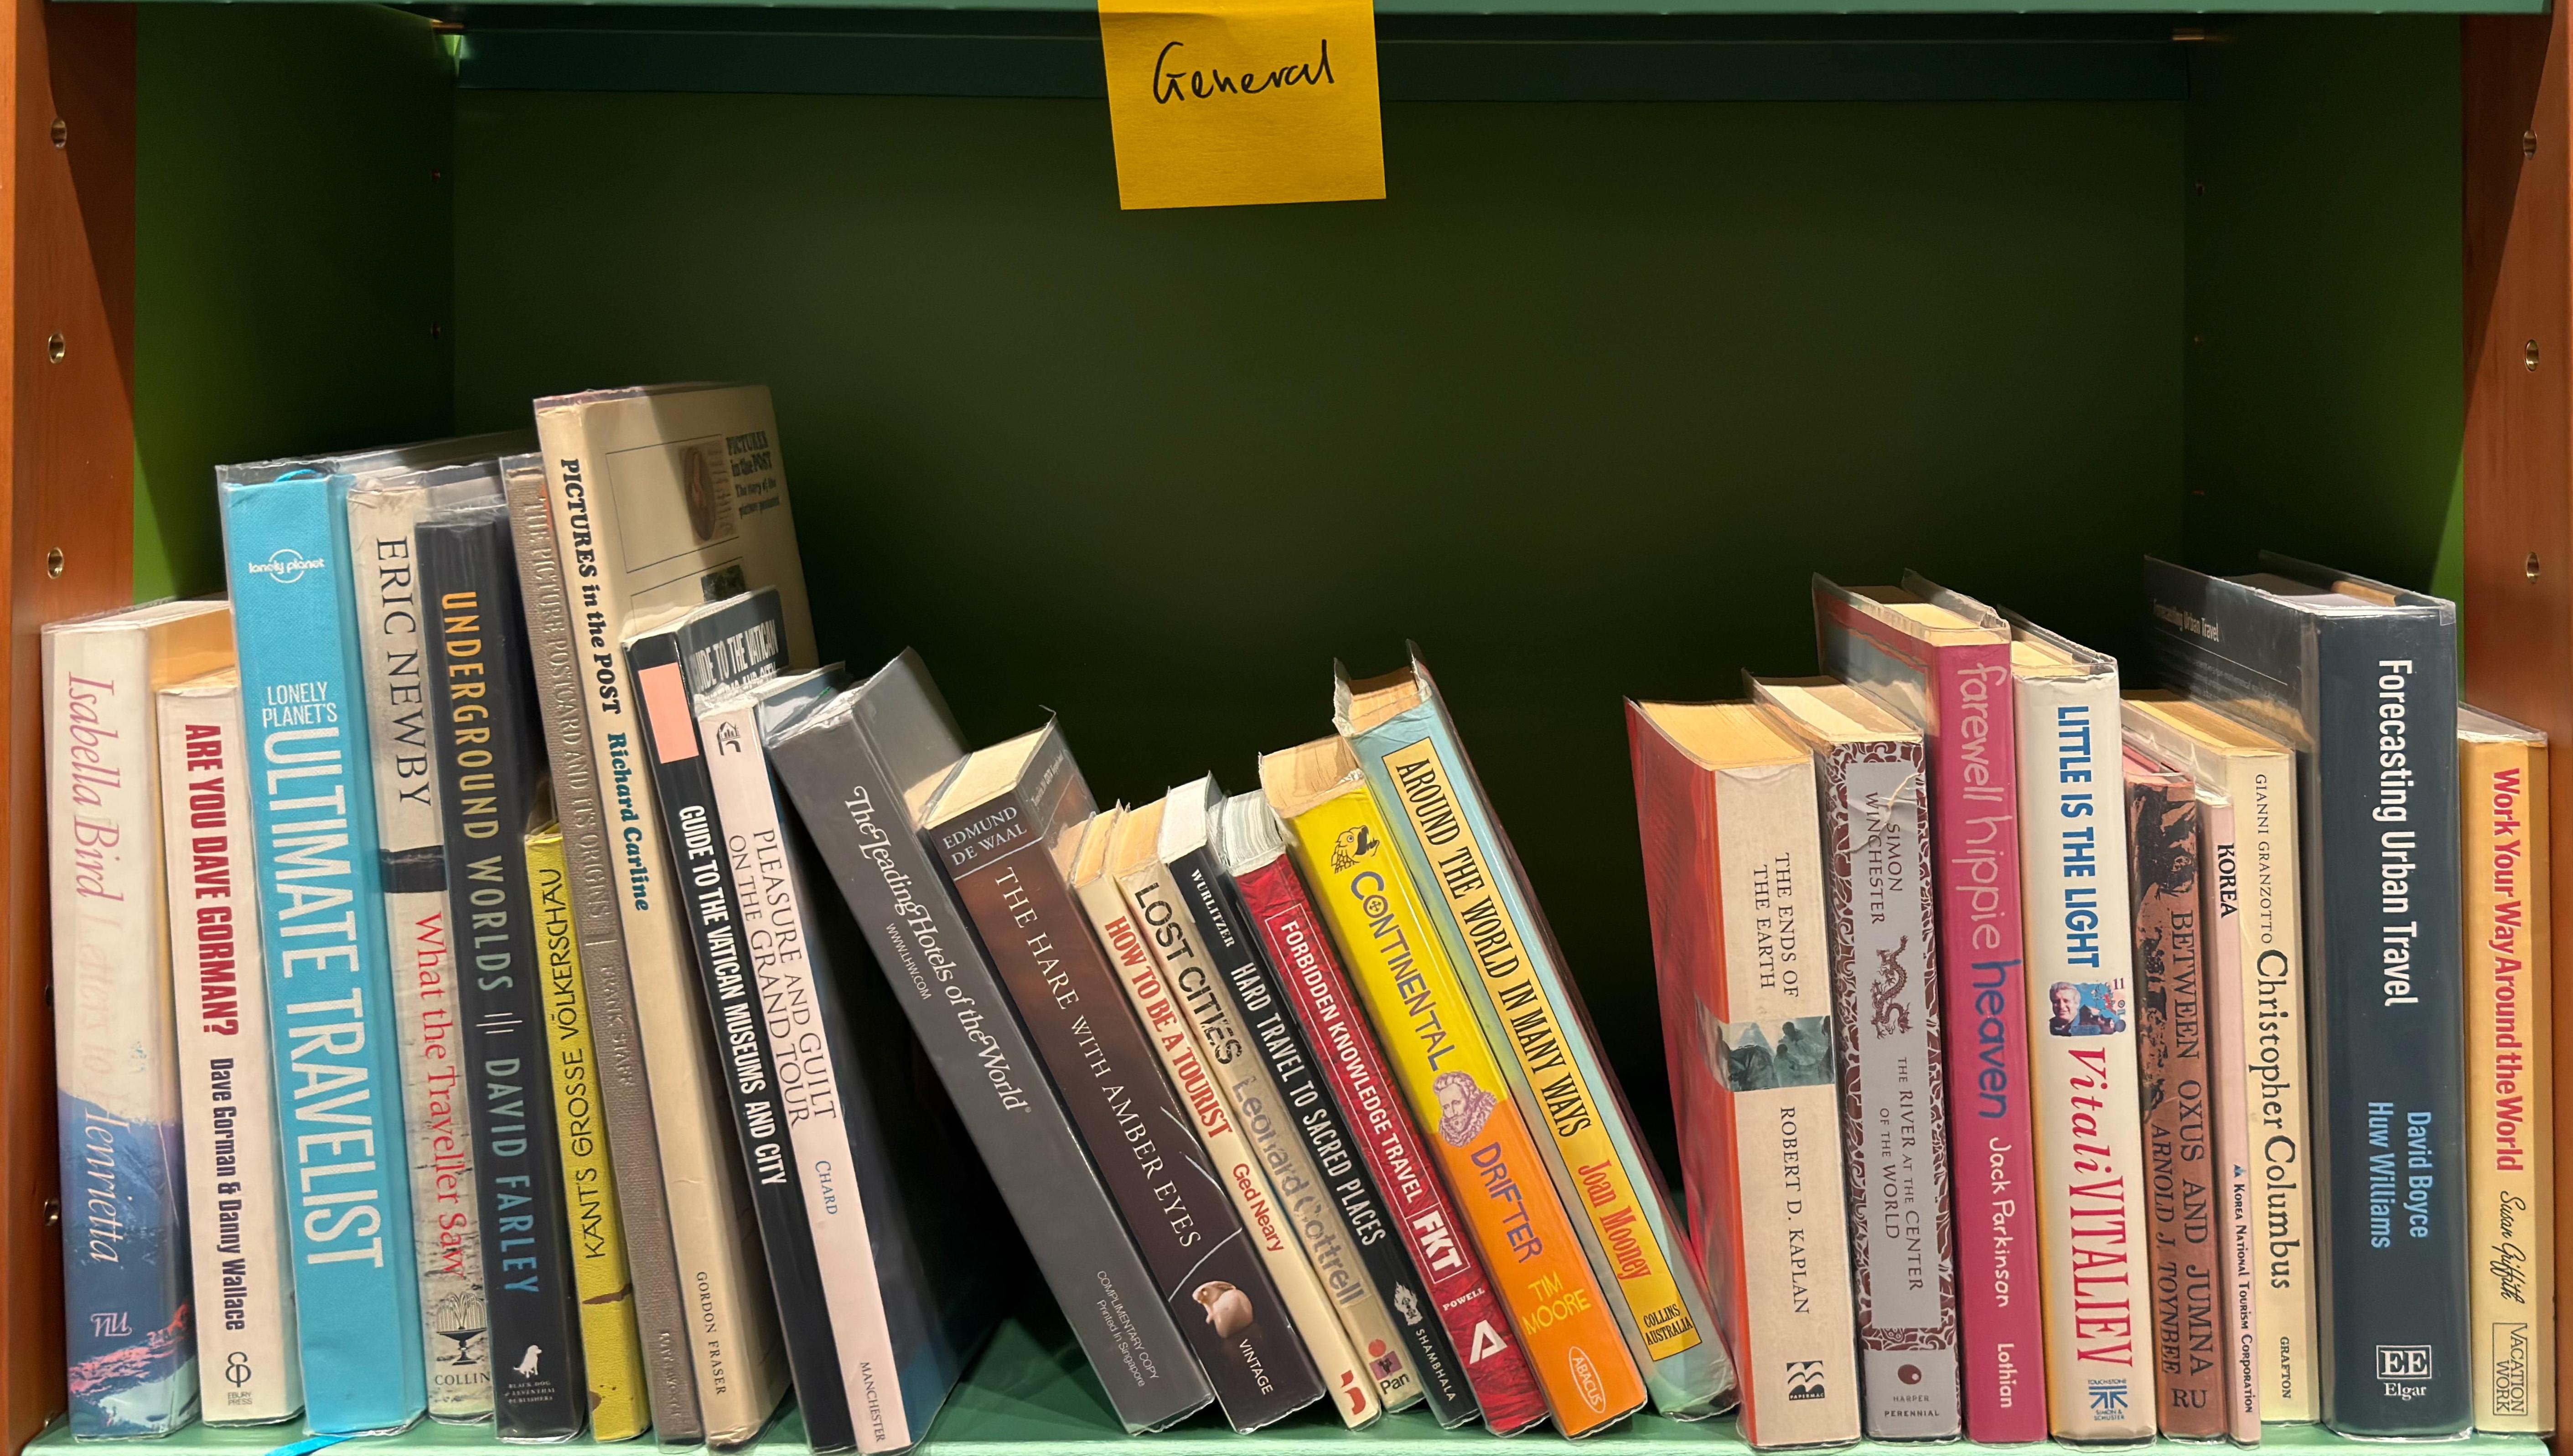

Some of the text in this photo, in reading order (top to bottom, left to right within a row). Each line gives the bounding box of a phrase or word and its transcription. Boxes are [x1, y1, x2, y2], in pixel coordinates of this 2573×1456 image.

[1153, 39, 1334, 103] General
[248, 558, 325, 574] lonely planet
[561, 458, 621, 714] PICTURES POST
[267, 682, 328, 706] LONELY
[377, 536, 431, 807] ERIC NEWBY
[547, 643, 581, 745] POSTCARD
[745, 619, 778, 666] VATICAN
[263, 703, 337, 728] PLANET'S
[68, 671, 124, 901] Isabella Bird
[441, 591, 513, 992] UNDERGROUND WORLDS
[608, 732, 648, 911] Richard Carline
[942, 806, 1018, 850] EDMUND
[980, 823, 1027, 855] WAAL
[2057, 706, 2100, 968] LITTLE LIGHT
[2373, 659, 2419, 1006] Forecasting Urban Travel
[185, 724, 239, 1036] ARE YOU DAVE GORMAN?
[1191, 869, 1235, 947] WURLITZER
[1865, 792, 1885, 924] WINCHESTER
[1886, 823, 1903, 892] SIMON
[1952, 662, 2022, 1118] farewell hippie heaven
[2217, 843, 2238, 919] KOREA
[2256, 774, 2274, 944] GIANNI GRANZOTTO
[754, 829, 836, 1118] PLEASURE AND GUILT
[885, 923, 931, 1001] WWW.LHW.COM
[1134, 883, 1194, 961] LOST
[1396, 758, 1592, 1138] AROUND WORLD MANY WAYS
[1757, 918, 1776, 989] EARTH
[1778, 904, 1796, 962] ENDS
[2489, 768, 2524, 1171] Work Your Way Around World
[264, 728, 384, 1268] ULTIMATE TRAVELIST
[679, 805, 787, 1186] GUIDE VATICAN MUSEUMS CITY
[738, 876, 810, 1127] THE GRAND TOUR
[1105, 916, 1233, 1138] HOW TOURIST
[415, 911, 467, 1276] What Traveller Saw
[562, 1048, 594, 1157] GROSSE
[1026, 932, 1202, 1248] HARE WITH AMBER EYES
[1232, 962, 1386, 1246] HARD TRAVEL SACRED PLACES
[1281, 920, 1422, 1204] FORBIDDEN KNOWLEDGE TRAVEL
[1351, 871, 1543, 1264] CONTINENTAL DRIFTER
[2170, 910, 2213, 1377] BETWEEN OXUS JUMNA
[2248, 950, 2300, 1290] Christopher Columbus
[210, 1058, 248, 1330] Dave Gorman Danny Wallace
[485, 1059, 539, 1293] DAVID FARLEY
[1232, 1075, 1365, 1307] Leonard Cottrell
[1232, 1163, 1285, 1252] Ged Neary
[1578, 1160, 1652, 1281] Joan Mooney
[1780, 1107, 1810, 1315] ROBERT KAPLAN
[1882, 1164, 1900, 1239] WORLD
[1899, 1090, 1924, 1291] RIVER CENTER
[1988, 1137, 2015, 1308] Jack Parkinson
[2068, 1047, 2133, 1368] Vitali VITALIEV
[2367, 1101, 2395, 1249] Huw Williams
[2403, 1111, 2433, 1239] David Boyce
[1412, 1210, 1462, 1274] FKT
[1527, 1275, 1563, 1300] TIM
[2151, 1124, 2181, 1374] ARNOLD TOYNBEE
[2490, 1190, 2526, 1305] Susan Griffith
[696, 1272, 726, 1396] GORDON FRASER
[1097, 1300, 1145, 1387] Printed Singapore
[1098, 1271, 1159, 1379] COMPLIMENTARY COPY
[1442, 1288, 1485, 1311] POWELL
[1522, 1290, 1591, 1337] MOORE
[1643, 1303, 1680, 1328] COLLINS
[1646, 1316, 1694, 1346] AUSTRALIA
[435, 1372, 491, 1386] COLLIN
[859, 1361, 886, 1443] MANCHESTER
[1239, 1339, 1274, 1395] VINTAGE
[1380, 1373, 1410, 1394] Pan
[1416, 1329, 1455, 1402] SHAMBHALA
[1572, 1356, 1603, 1406] ABACUS
[1997, 1342, 2014, 1408] Lothian
[2171, 1389, 2208, 1408] RU
[2279, 1336, 2292, 1399] GRAFTON
[2381, 1350, 2428, 1375] EE
[2384, 1382, 2427, 1400] Elgar
[2495, 1360, 2510, 1412] WORK
[2510, 1323, 2526, 1414] VACATION
